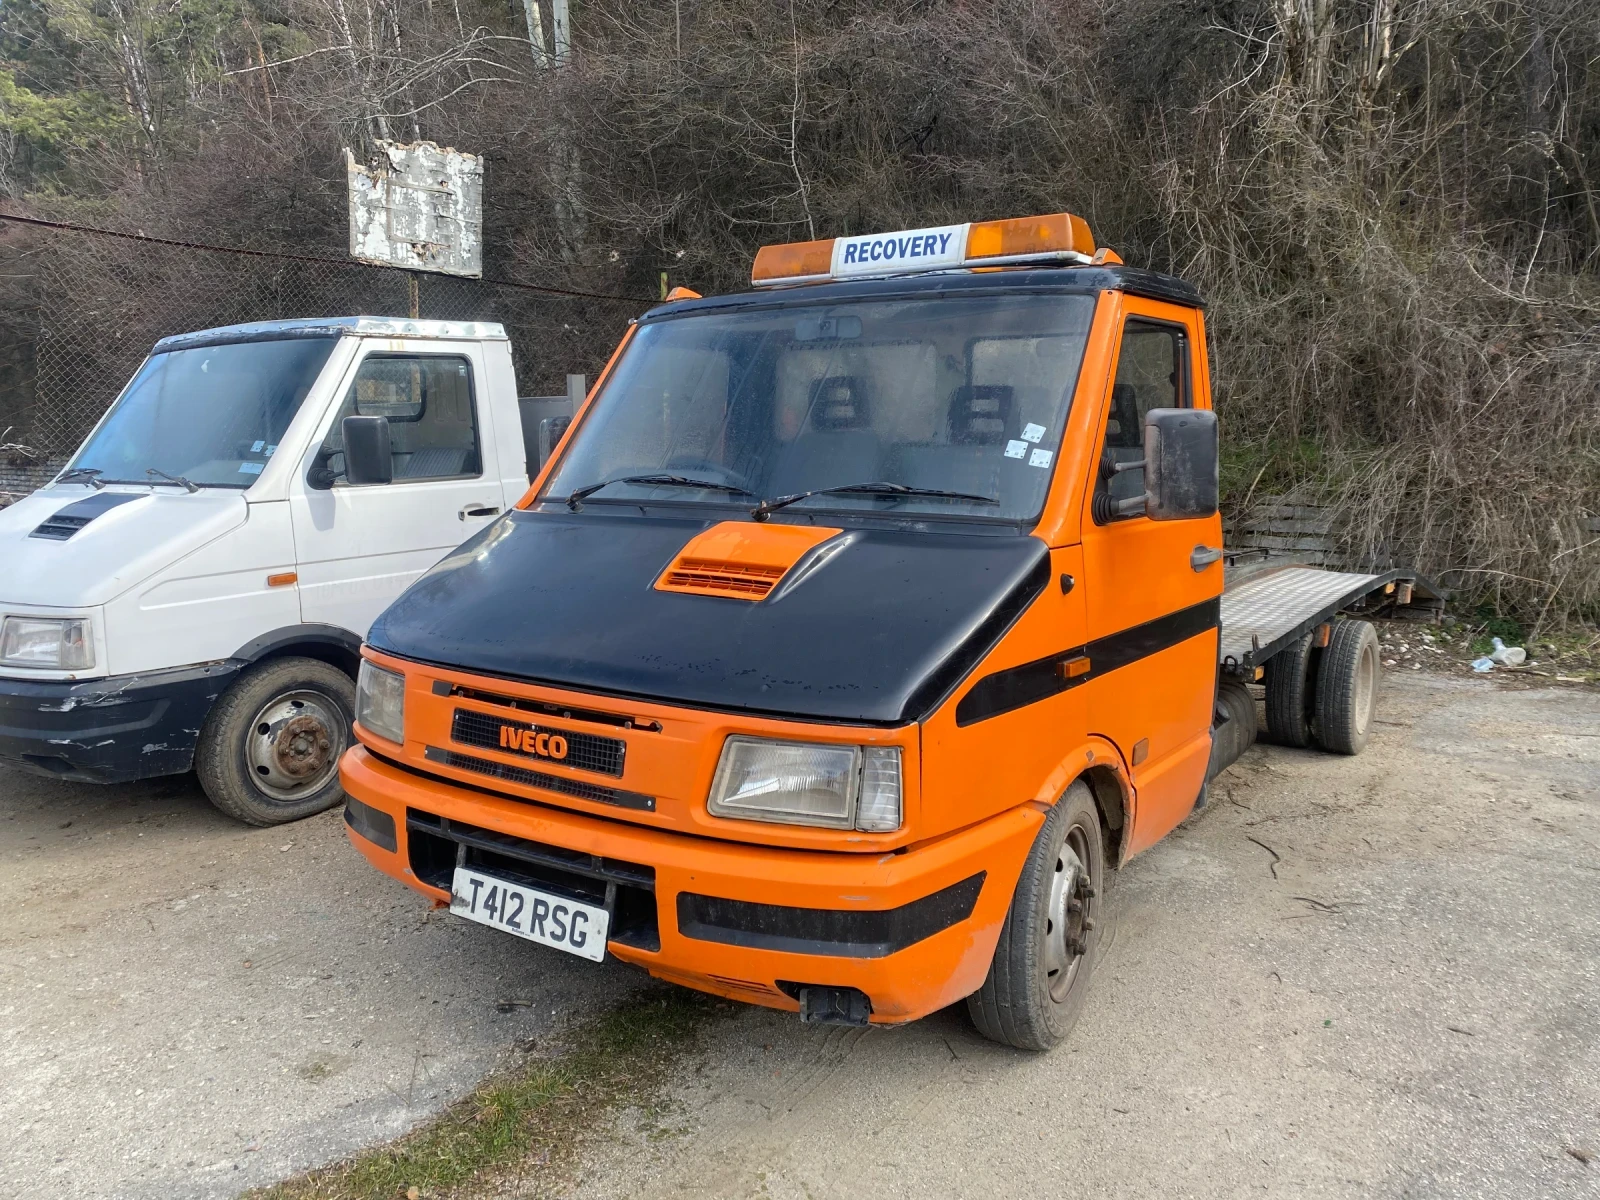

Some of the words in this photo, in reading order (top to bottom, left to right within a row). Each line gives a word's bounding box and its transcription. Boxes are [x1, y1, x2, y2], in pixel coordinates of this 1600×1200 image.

[844, 233, 953, 264] RECOVERY
[500, 725, 568, 760] IVECO
[469, 878, 525, 929] T412
[529, 898, 589, 949] RSG
